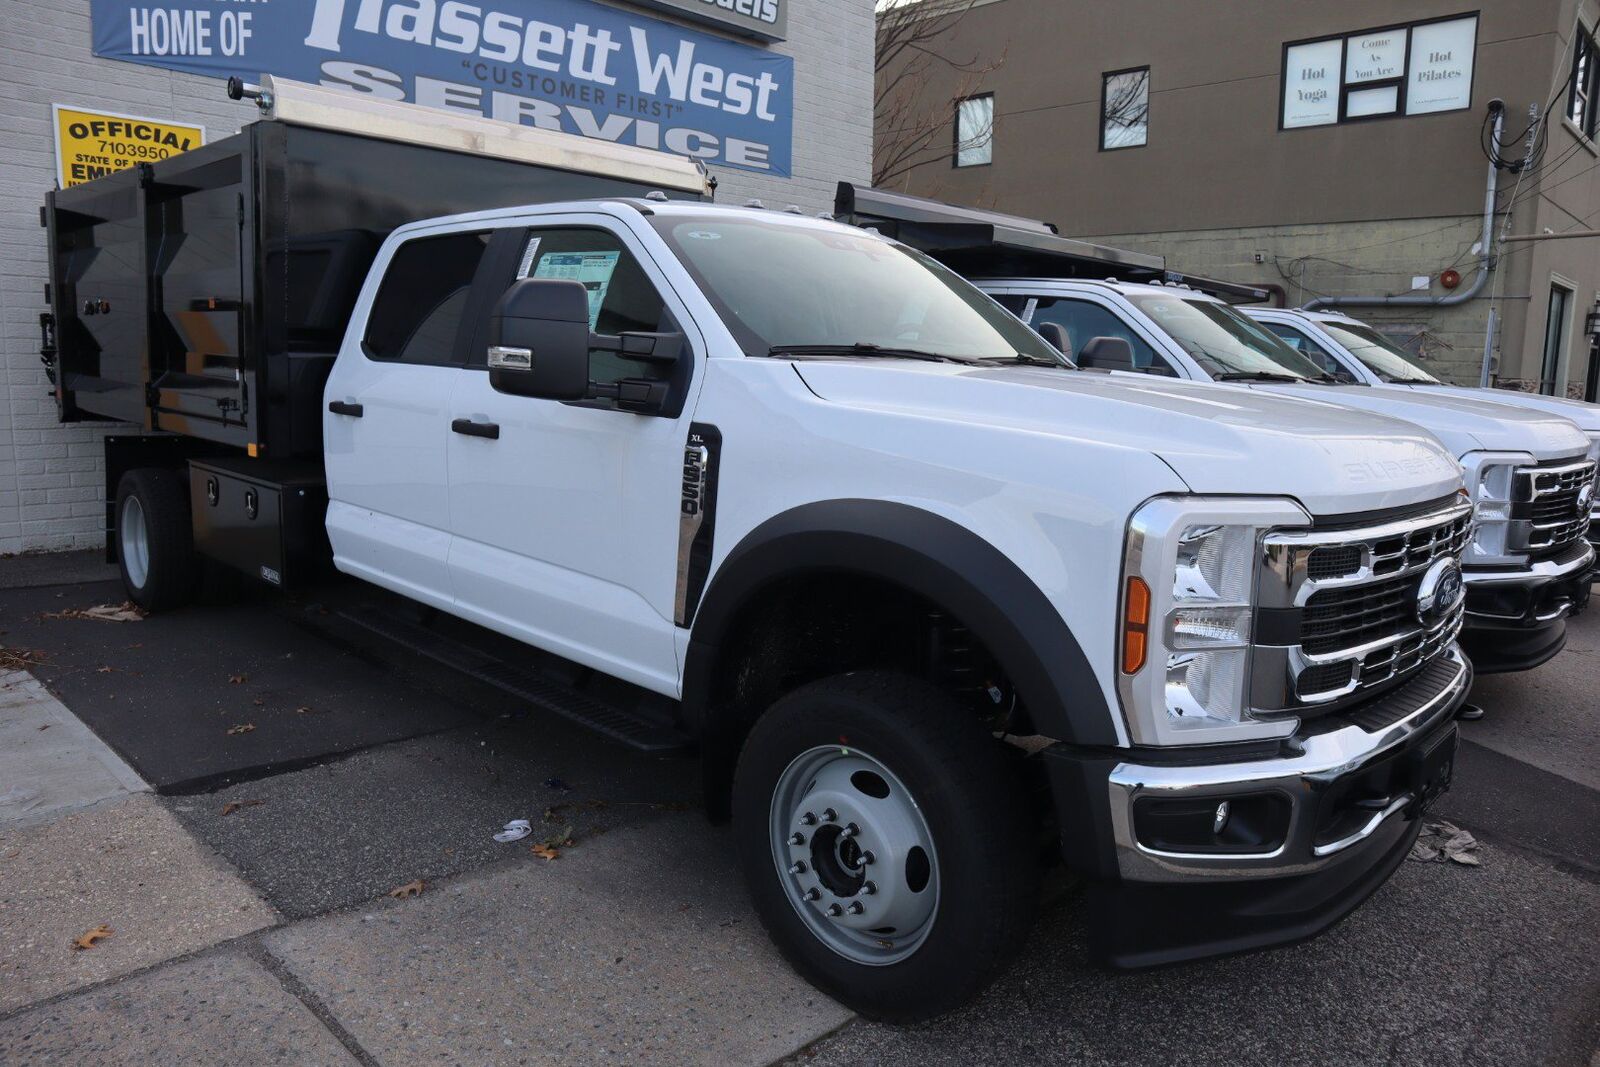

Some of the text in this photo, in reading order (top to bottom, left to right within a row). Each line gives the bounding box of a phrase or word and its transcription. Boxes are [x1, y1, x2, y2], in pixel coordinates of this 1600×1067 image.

[130, 8, 252, 56] HOME OF
[1361, 37, 1391, 49] Come
[1370, 52, 1381, 63] As
[1429, 51, 1452, 63] Hot
[629, 26, 778, 121] West
[1301, 67, 1325, 80] Hot
[1355, 66, 1394, 79] You Are
[1417, 68, 1462, 83] Pilates
[1297, 88, 1328, 104] Yoga
[320, 60, 770, 169] SERVICE
[97, 140, 169, 159] 7103950
[76, 154, 110, 165] STATE
[114, 158, 129, 167] OF
[691, 434, 704, 442] XL
